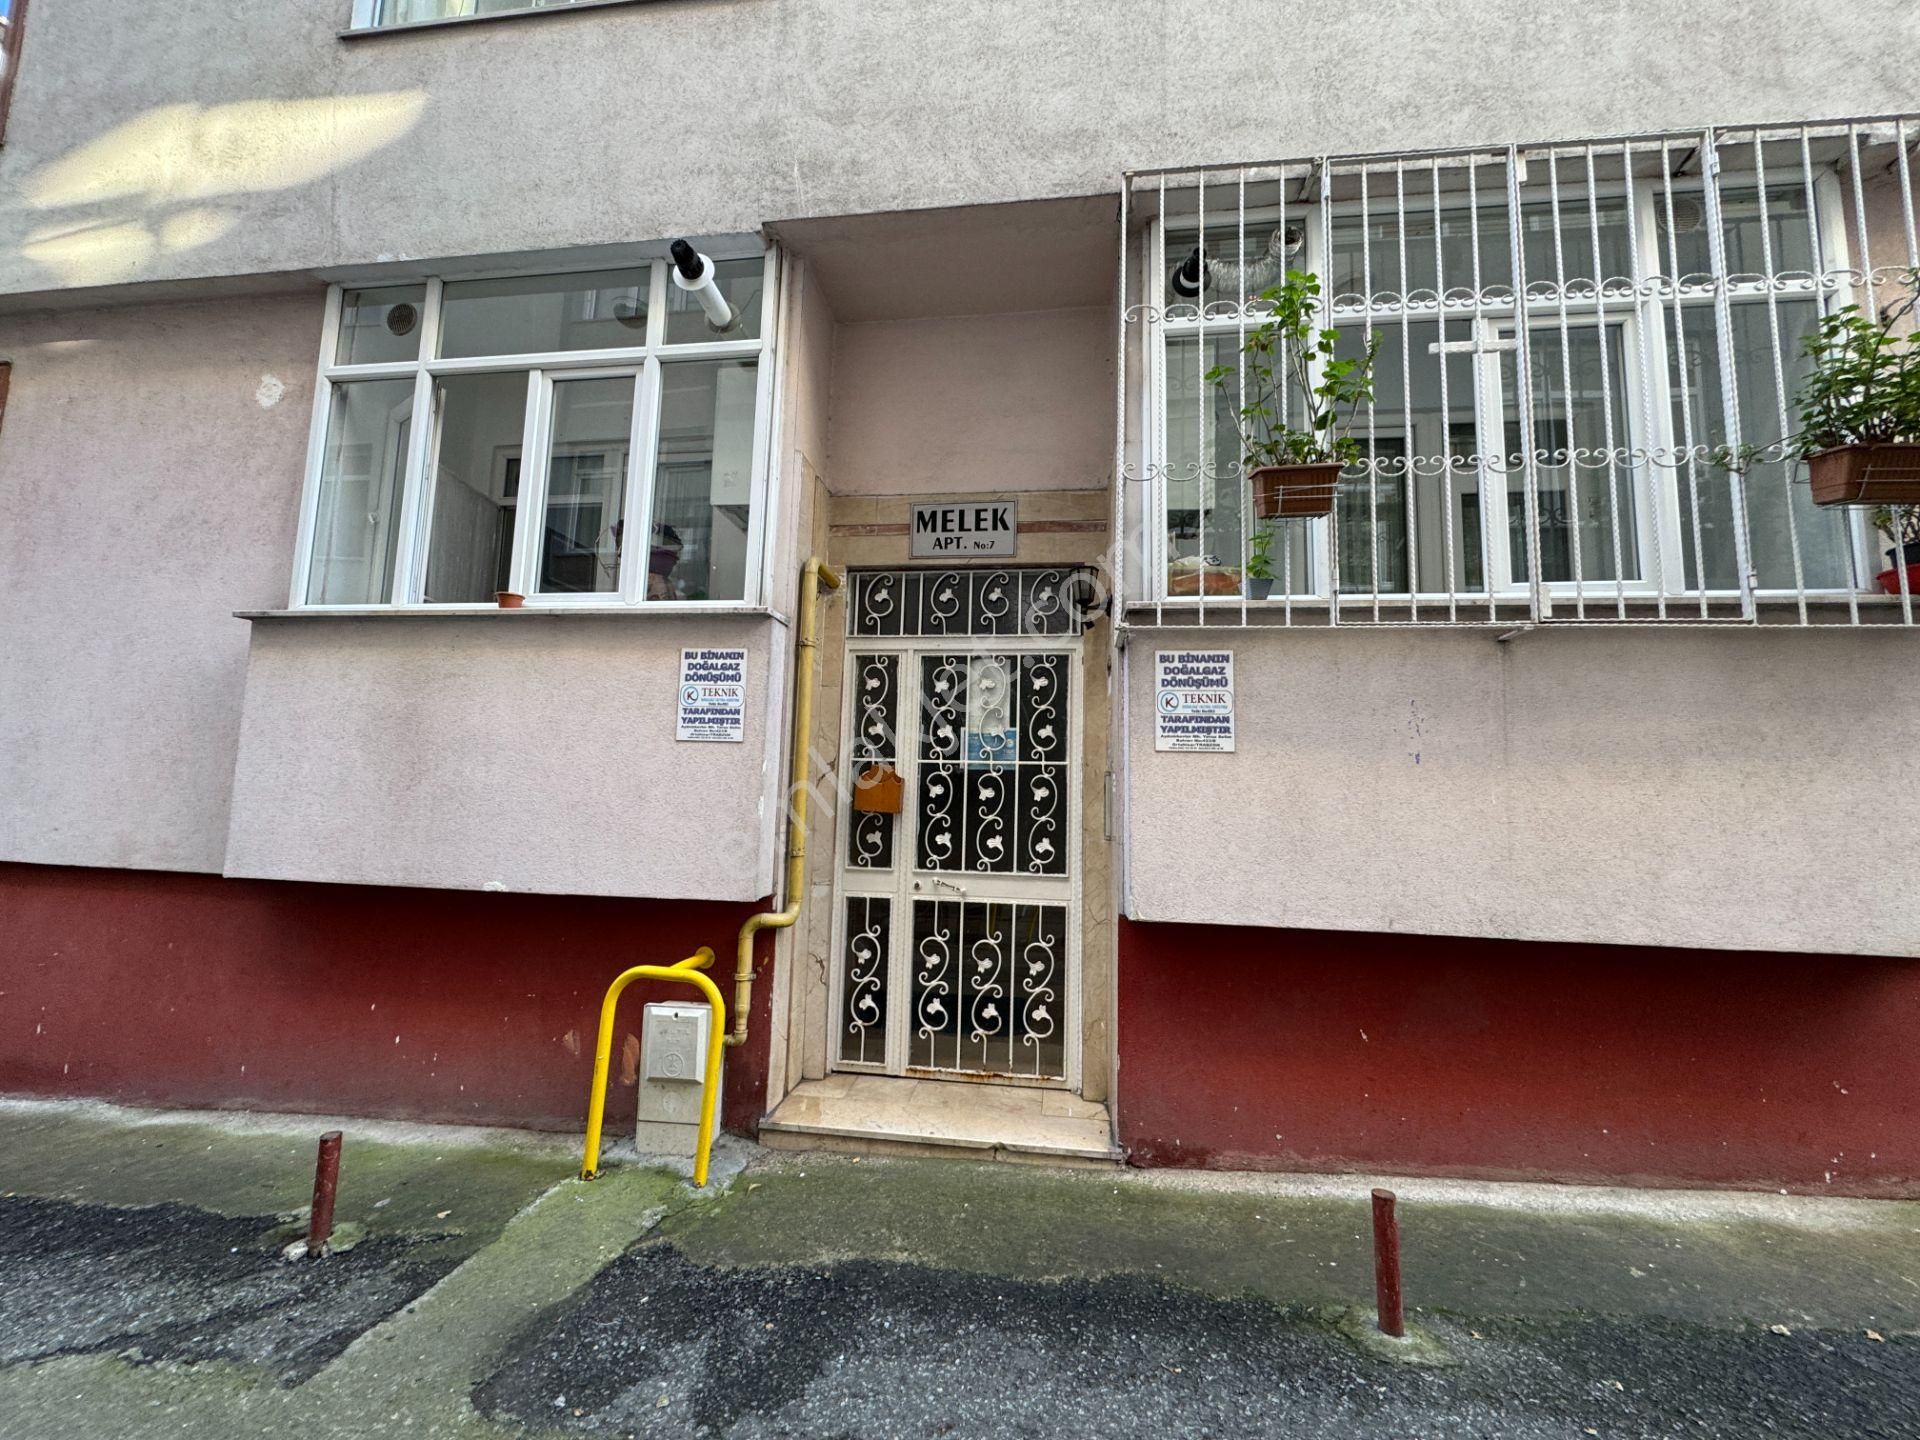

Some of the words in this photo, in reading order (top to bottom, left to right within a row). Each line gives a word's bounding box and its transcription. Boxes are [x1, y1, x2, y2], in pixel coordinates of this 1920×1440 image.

[916, 508, 1010, 534] MELEK
[932, 536, 967, 550] APT.
[973, 540, 995, 550] No:7
[684, 651, 699, 660] BU
[700, 650, 744, 660] BİNANIN
[1159, 654, 1174, 664] BU
[1178, 652, 1230, 664] BİNANIN
[687, 661, 740, 671] DOĞALGAZ
[1163, 664, 1226, 676] DOĞALGAZ
[684, 672, 742, 683] DÖNÜŞÜMÜ
[1161, 676, 1228, 689] DÖNÜŞÜMÜ
[682, 707, 741, 716] TARAFINDAN
[681, 716, 742, 726] YAPILMIŞTIR
[1160, 715, 1230, 724] TARAFINDAN
[1160, 725, 1232, 735] YAPILMIŞTIR
